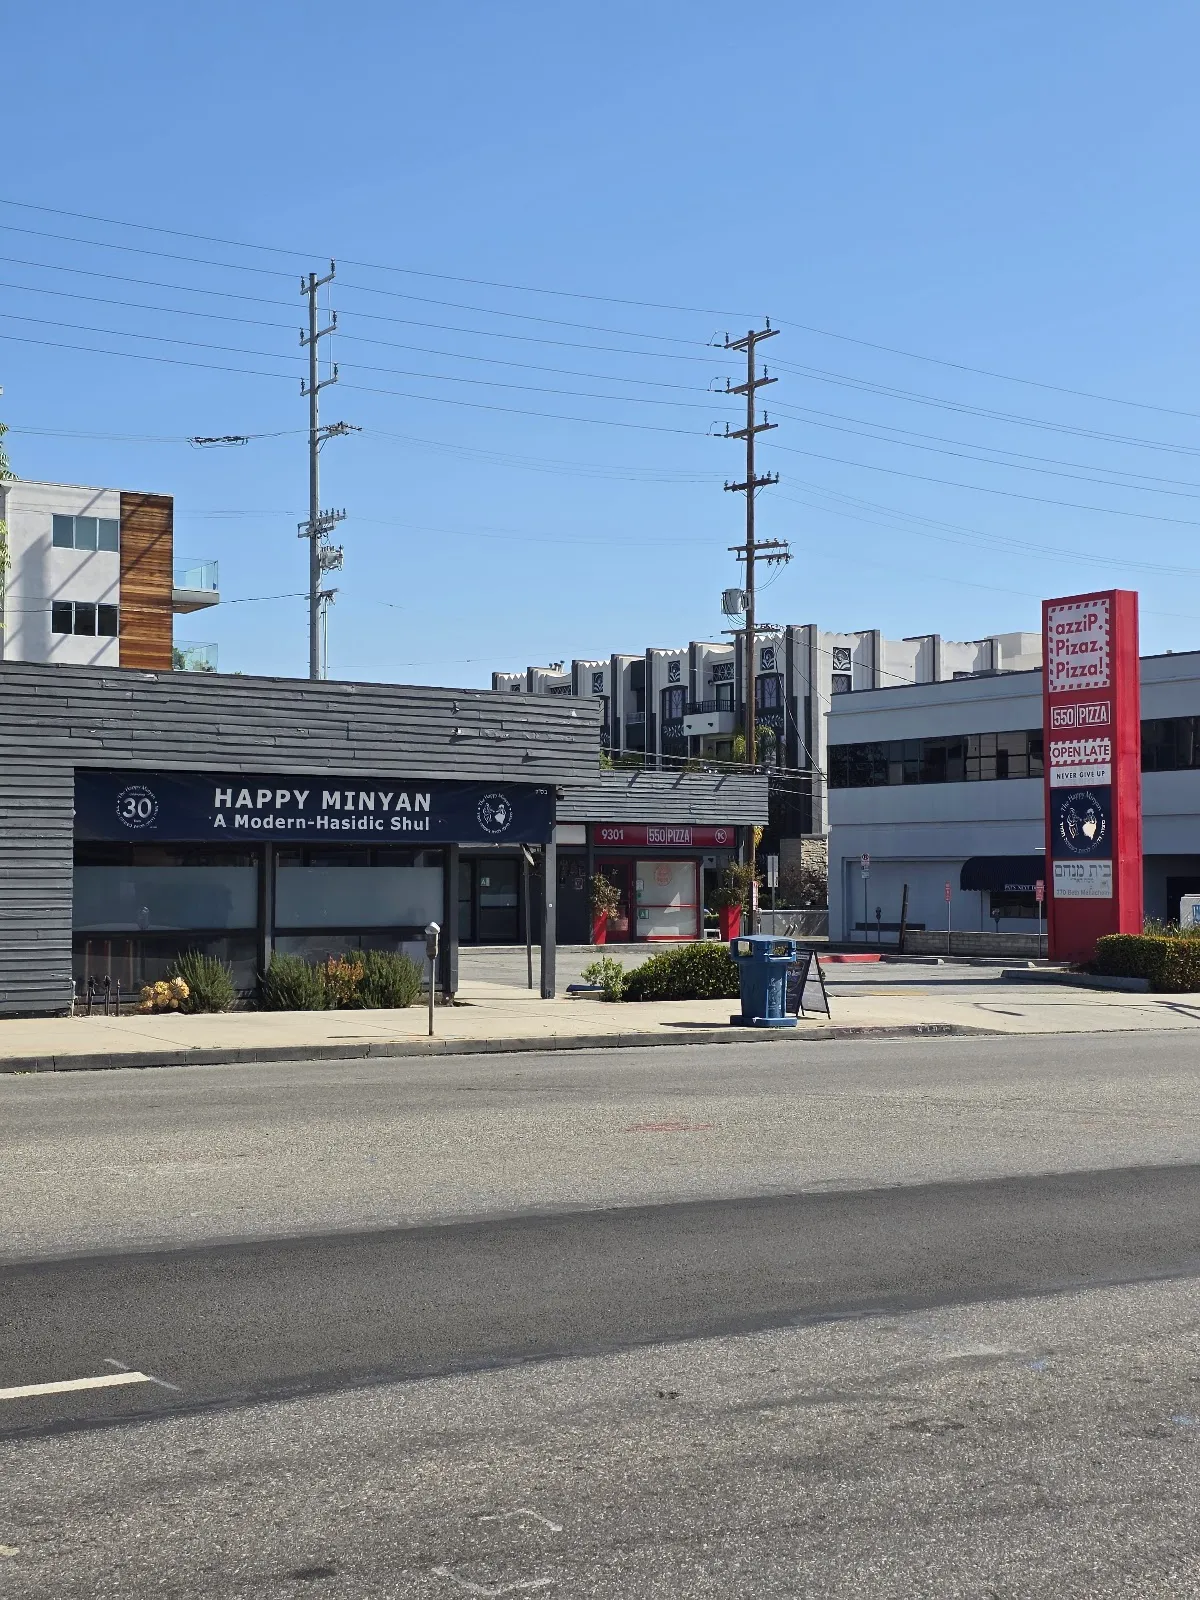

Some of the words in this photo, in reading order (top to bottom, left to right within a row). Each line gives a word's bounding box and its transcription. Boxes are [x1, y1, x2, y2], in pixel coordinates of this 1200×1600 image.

[1055, 613, 1103, 635] azziP.
[1055, 638, 1103, 657] Pizaz.
[1055, 656, 1103, 680] Pizza!
[1053, 708, 1074, 726] 550
[1079, 705, 1107, 724] PIZZA
[1052, 746, 1080, 758] OPEN
[1083, 744, 1110, 757] LATE
[1056, 772, 1077, 780] NEVER
[122, 797, 152, 819] 30
[214, 788, 310, 810] HAPPY
[321, 790, 431, 812] MINYAN
[1061, 801, 1069, 811] The
[1068, 793, 1085, 802] Happy
[1086, 791, 1101, 811] Minyan
[213, 813, 227, 828] A
[234, 814, 384, 831] Modern-Hasidic
[390, 816, 430, 831] Shul
[601, 828, 624, 840] 9301
[649, 828, 666, 842] 550
[668, 829, 690, 842] PIZZA
[1055, 864, 1085, 878] מנחם
[1089, 864, 1111, 878] בית
